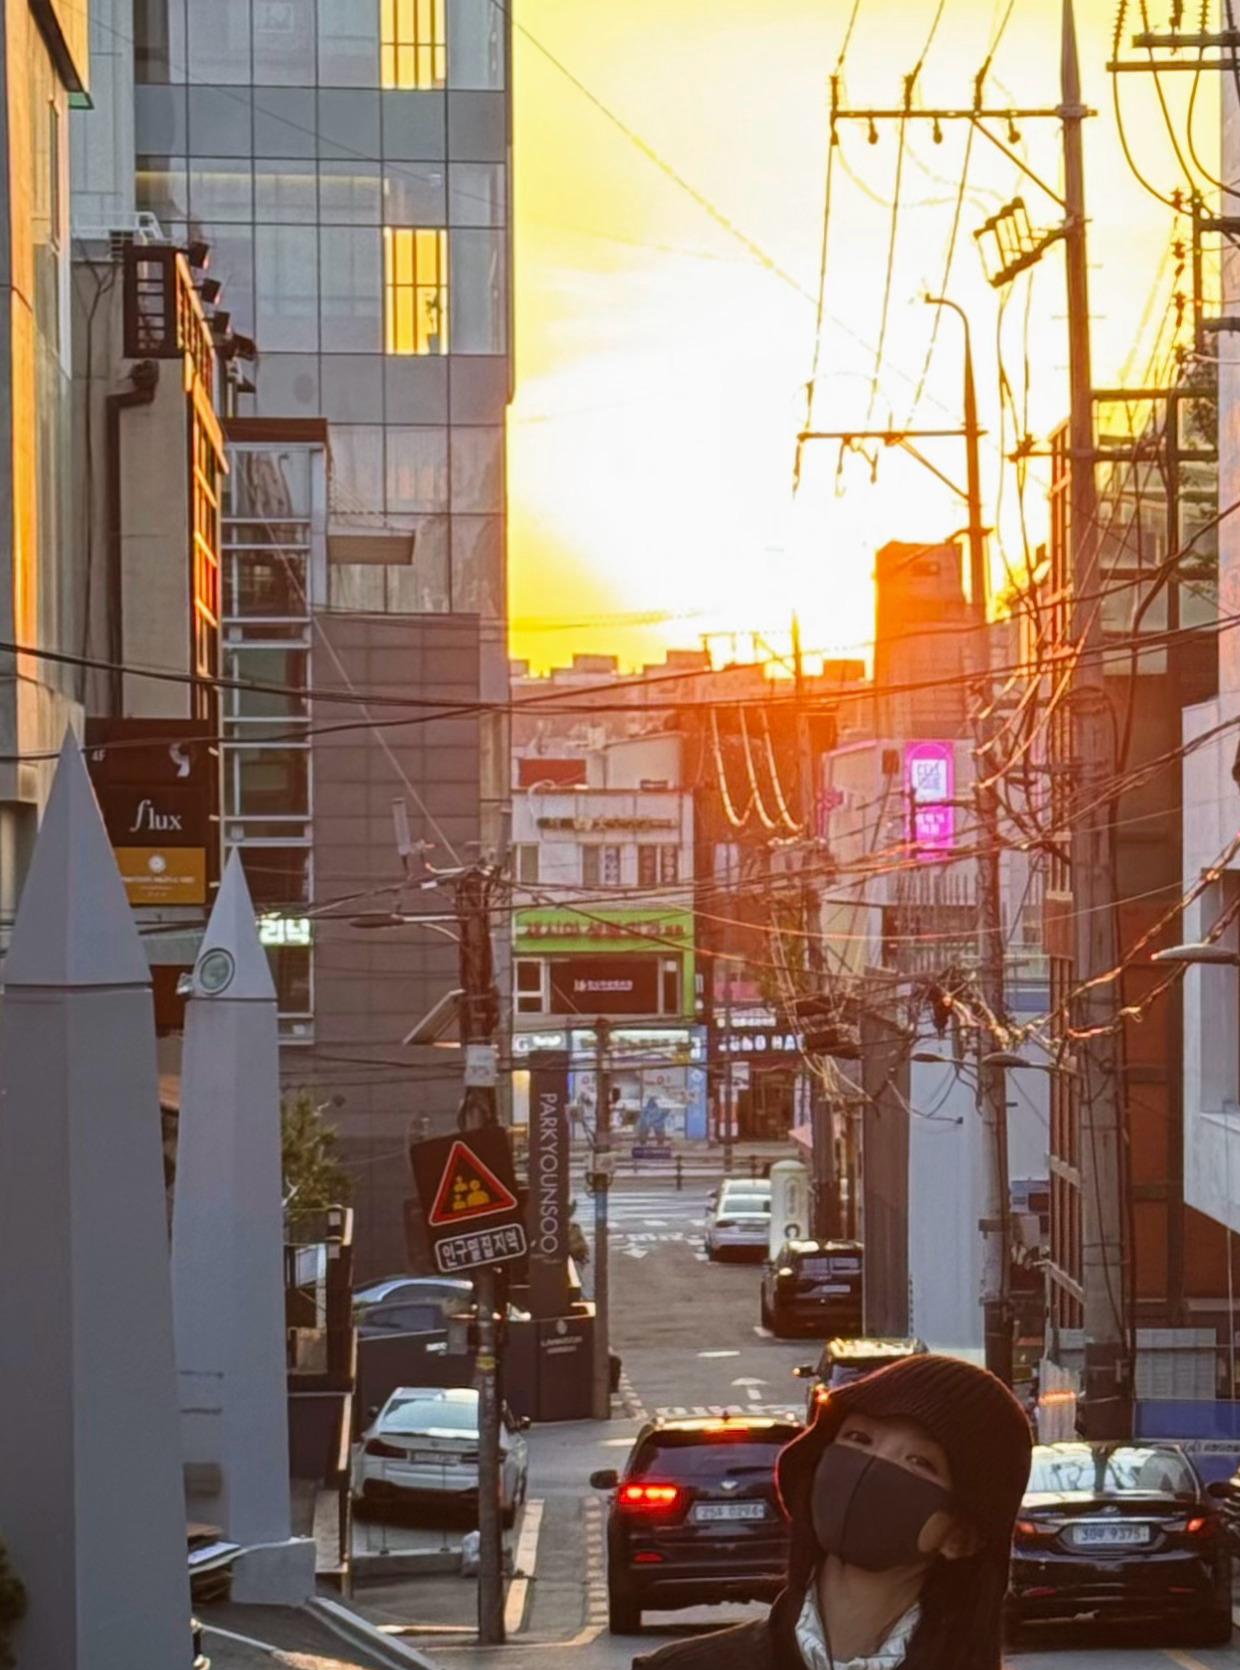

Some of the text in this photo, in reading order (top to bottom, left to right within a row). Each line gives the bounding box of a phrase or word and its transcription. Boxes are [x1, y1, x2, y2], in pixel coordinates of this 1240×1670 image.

[129, 799, 182, 832] flux
[540, 1093, 558, 1254] PARKYOUNSOO
[442, 1229, 520, 1267] 인구밀집지역
